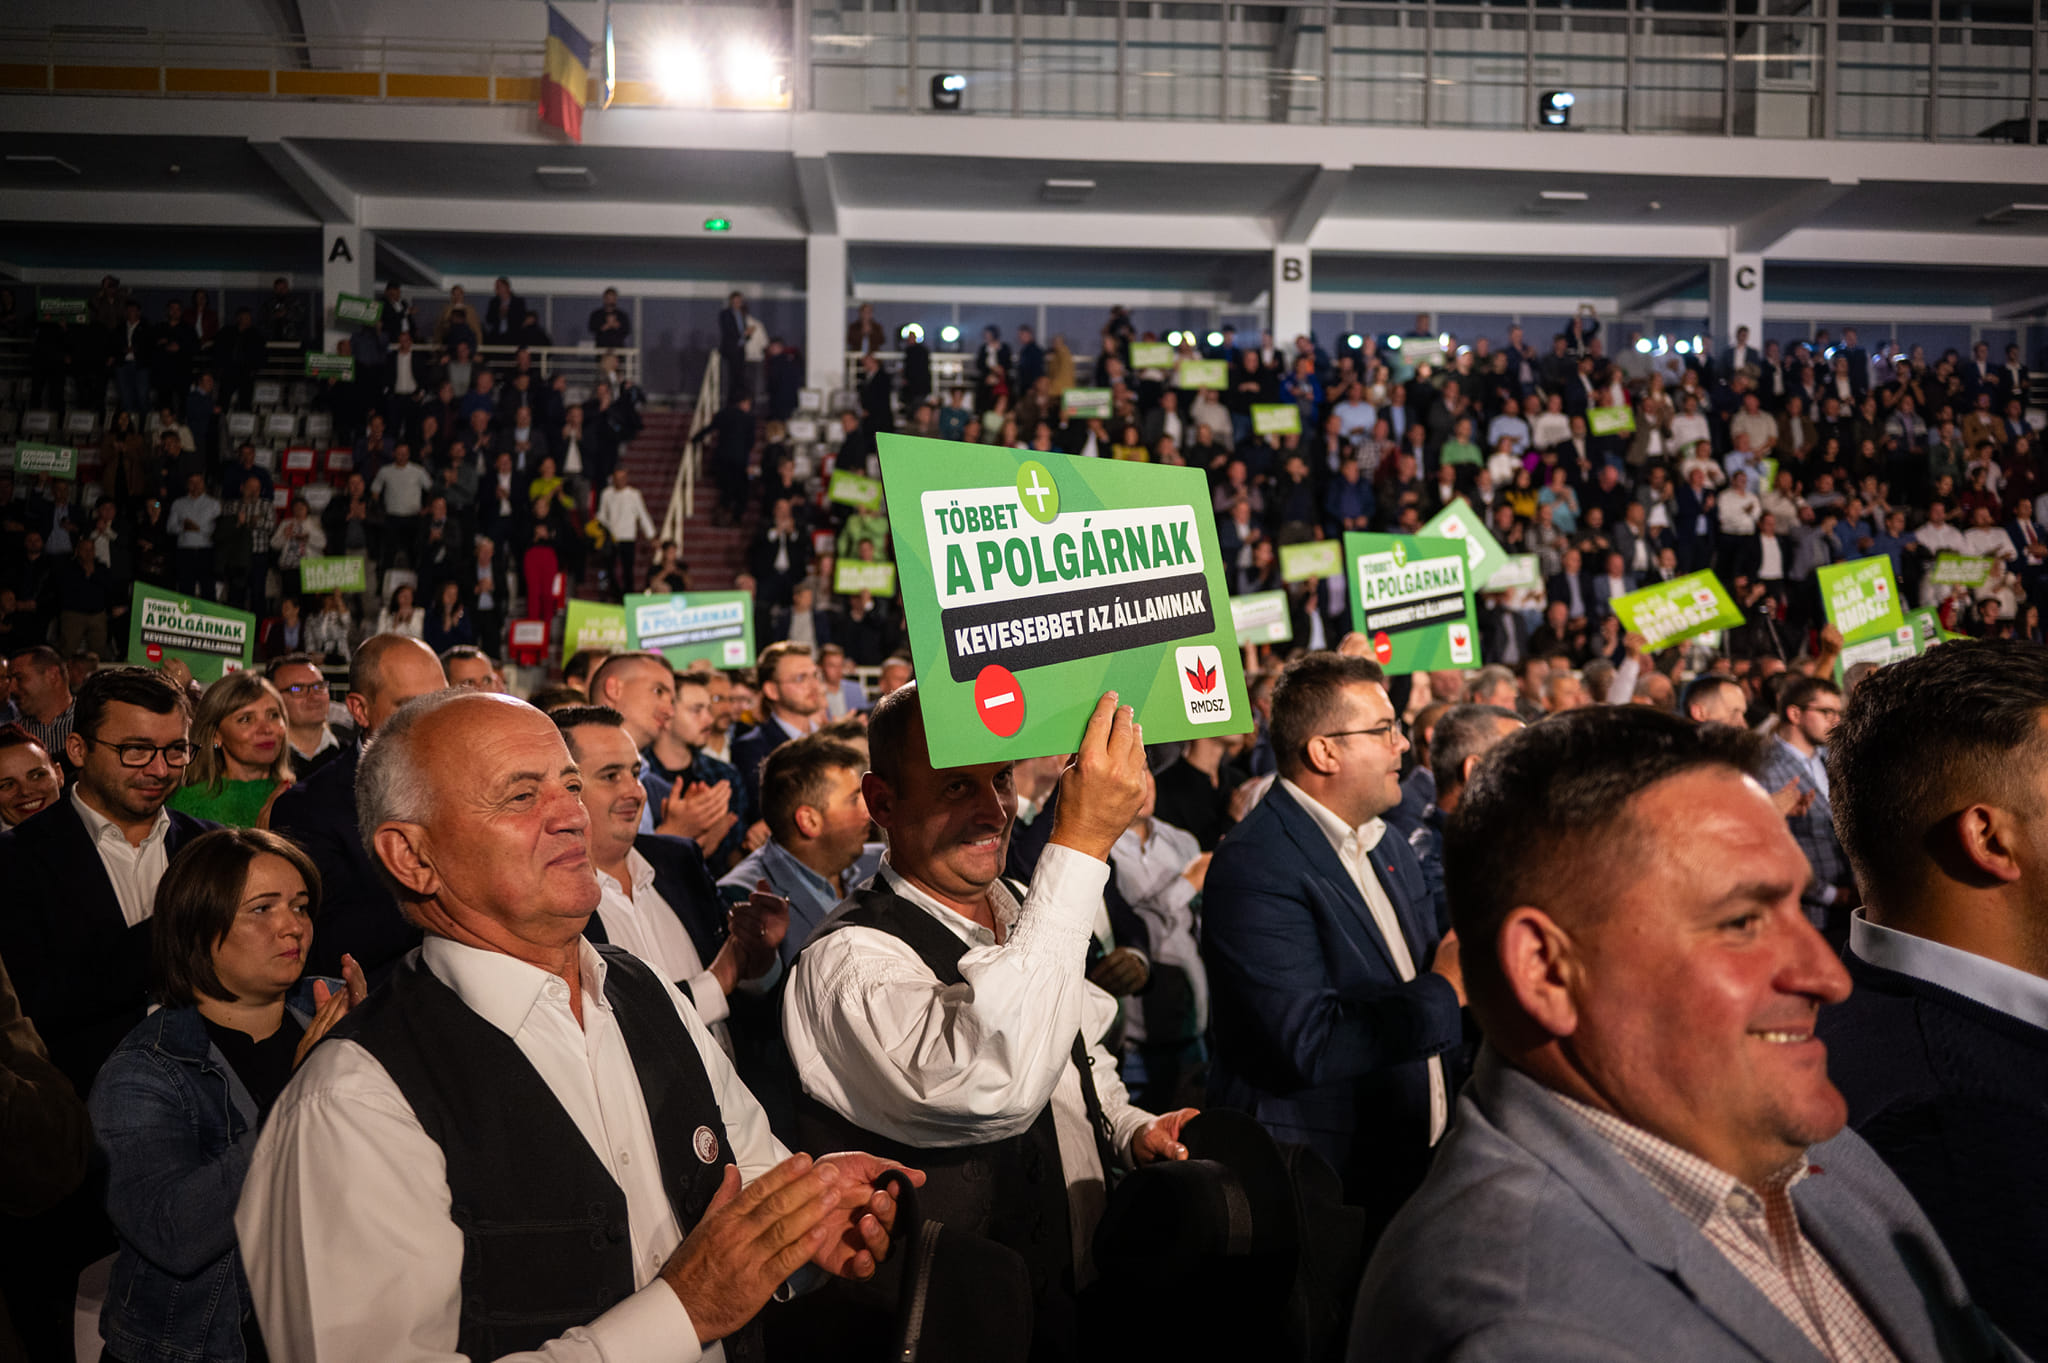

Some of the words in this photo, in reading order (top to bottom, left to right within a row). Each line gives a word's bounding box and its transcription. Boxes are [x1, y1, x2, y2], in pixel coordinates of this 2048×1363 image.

[328, 236, 352, 262] A
[1283, 258, 1302, 281] B
[1737, 266, 1755, 290] C
[935, 501, 1018, 535] TÖBBET
[946, 543, 976, 596] A
[976, 518, 1196, 591] POLGÁRNAK
[1364, 561, 1392, 575] TÖBBET
[1366, 580, 1375, 601] A
[1378, 564, 1460, 600] POLGÁRNAK
[148, 603, 176, 613] TÖBBET
[146, 613, 155, 625] A
[158, 615, 242, 638] POLGÁRNAK
[955, 610, 1084, 656] KEVESEBBET
[1088, 606, 1113, 632] AZ
[1114, 590, 1206, 628] ÁLLAMNAK
[1191, 699, 1225, 713] RMDSZ
